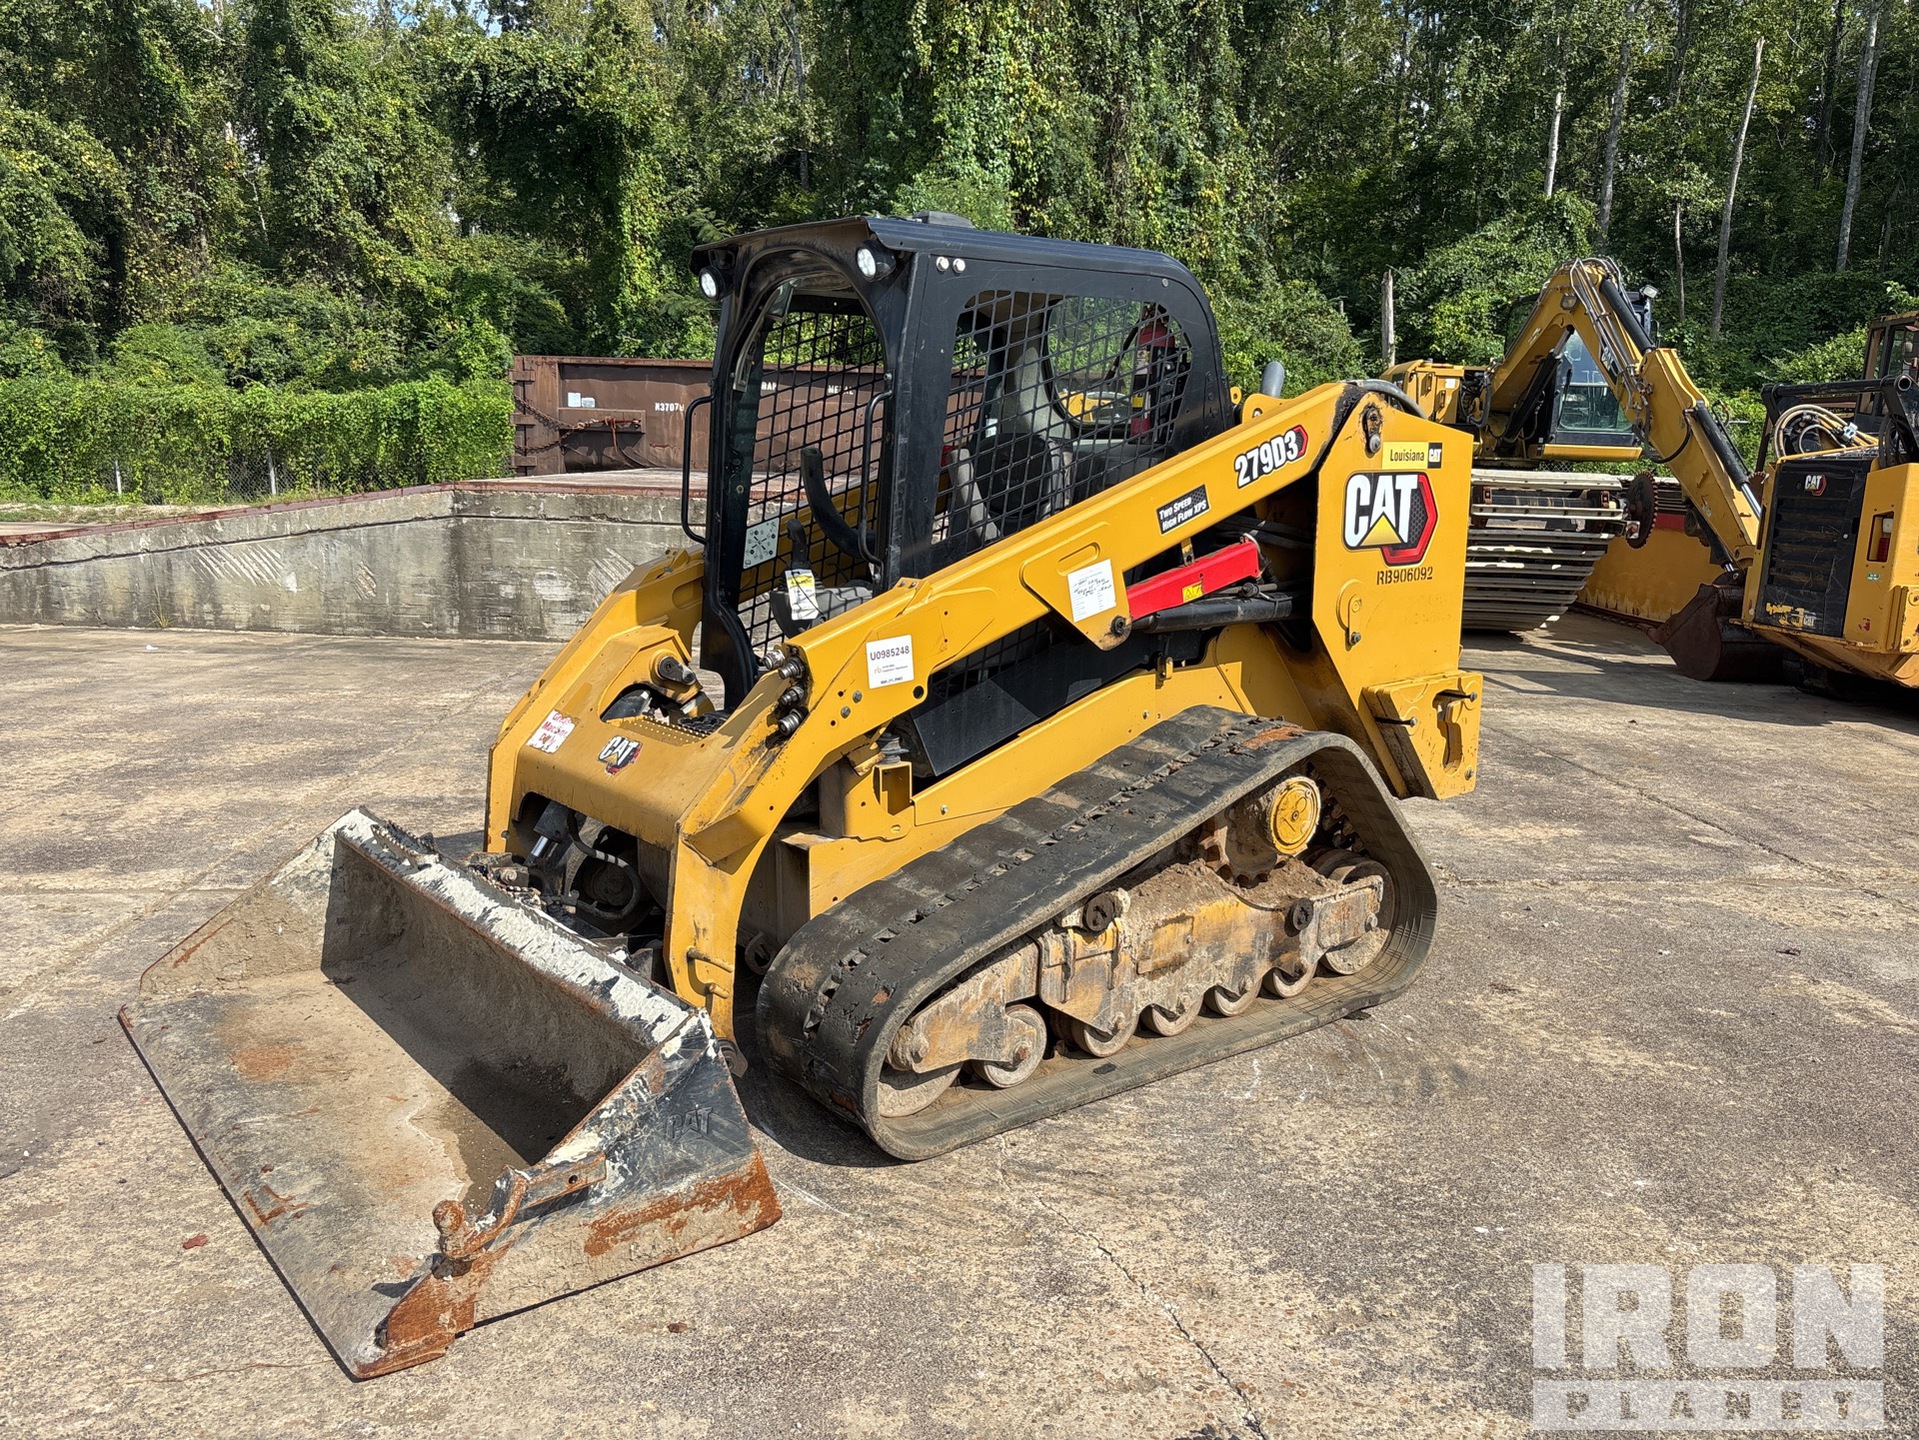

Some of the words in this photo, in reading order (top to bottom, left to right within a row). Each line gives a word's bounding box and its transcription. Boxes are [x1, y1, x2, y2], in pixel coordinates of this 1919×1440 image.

[1235, 430, 1299, 488] 279D3
[1390, 448, 1425, 462] Louisiana
[1429, 448, 1442, 463] CAT
[1804, 474, 1822, 490] CAT
[1344, 474, 1419, 548] CAT
[1376, 566, 1434, 586] RB906092
[870, 645, 910, 661] U0985248
[599, 735, 640, 766] CAT
